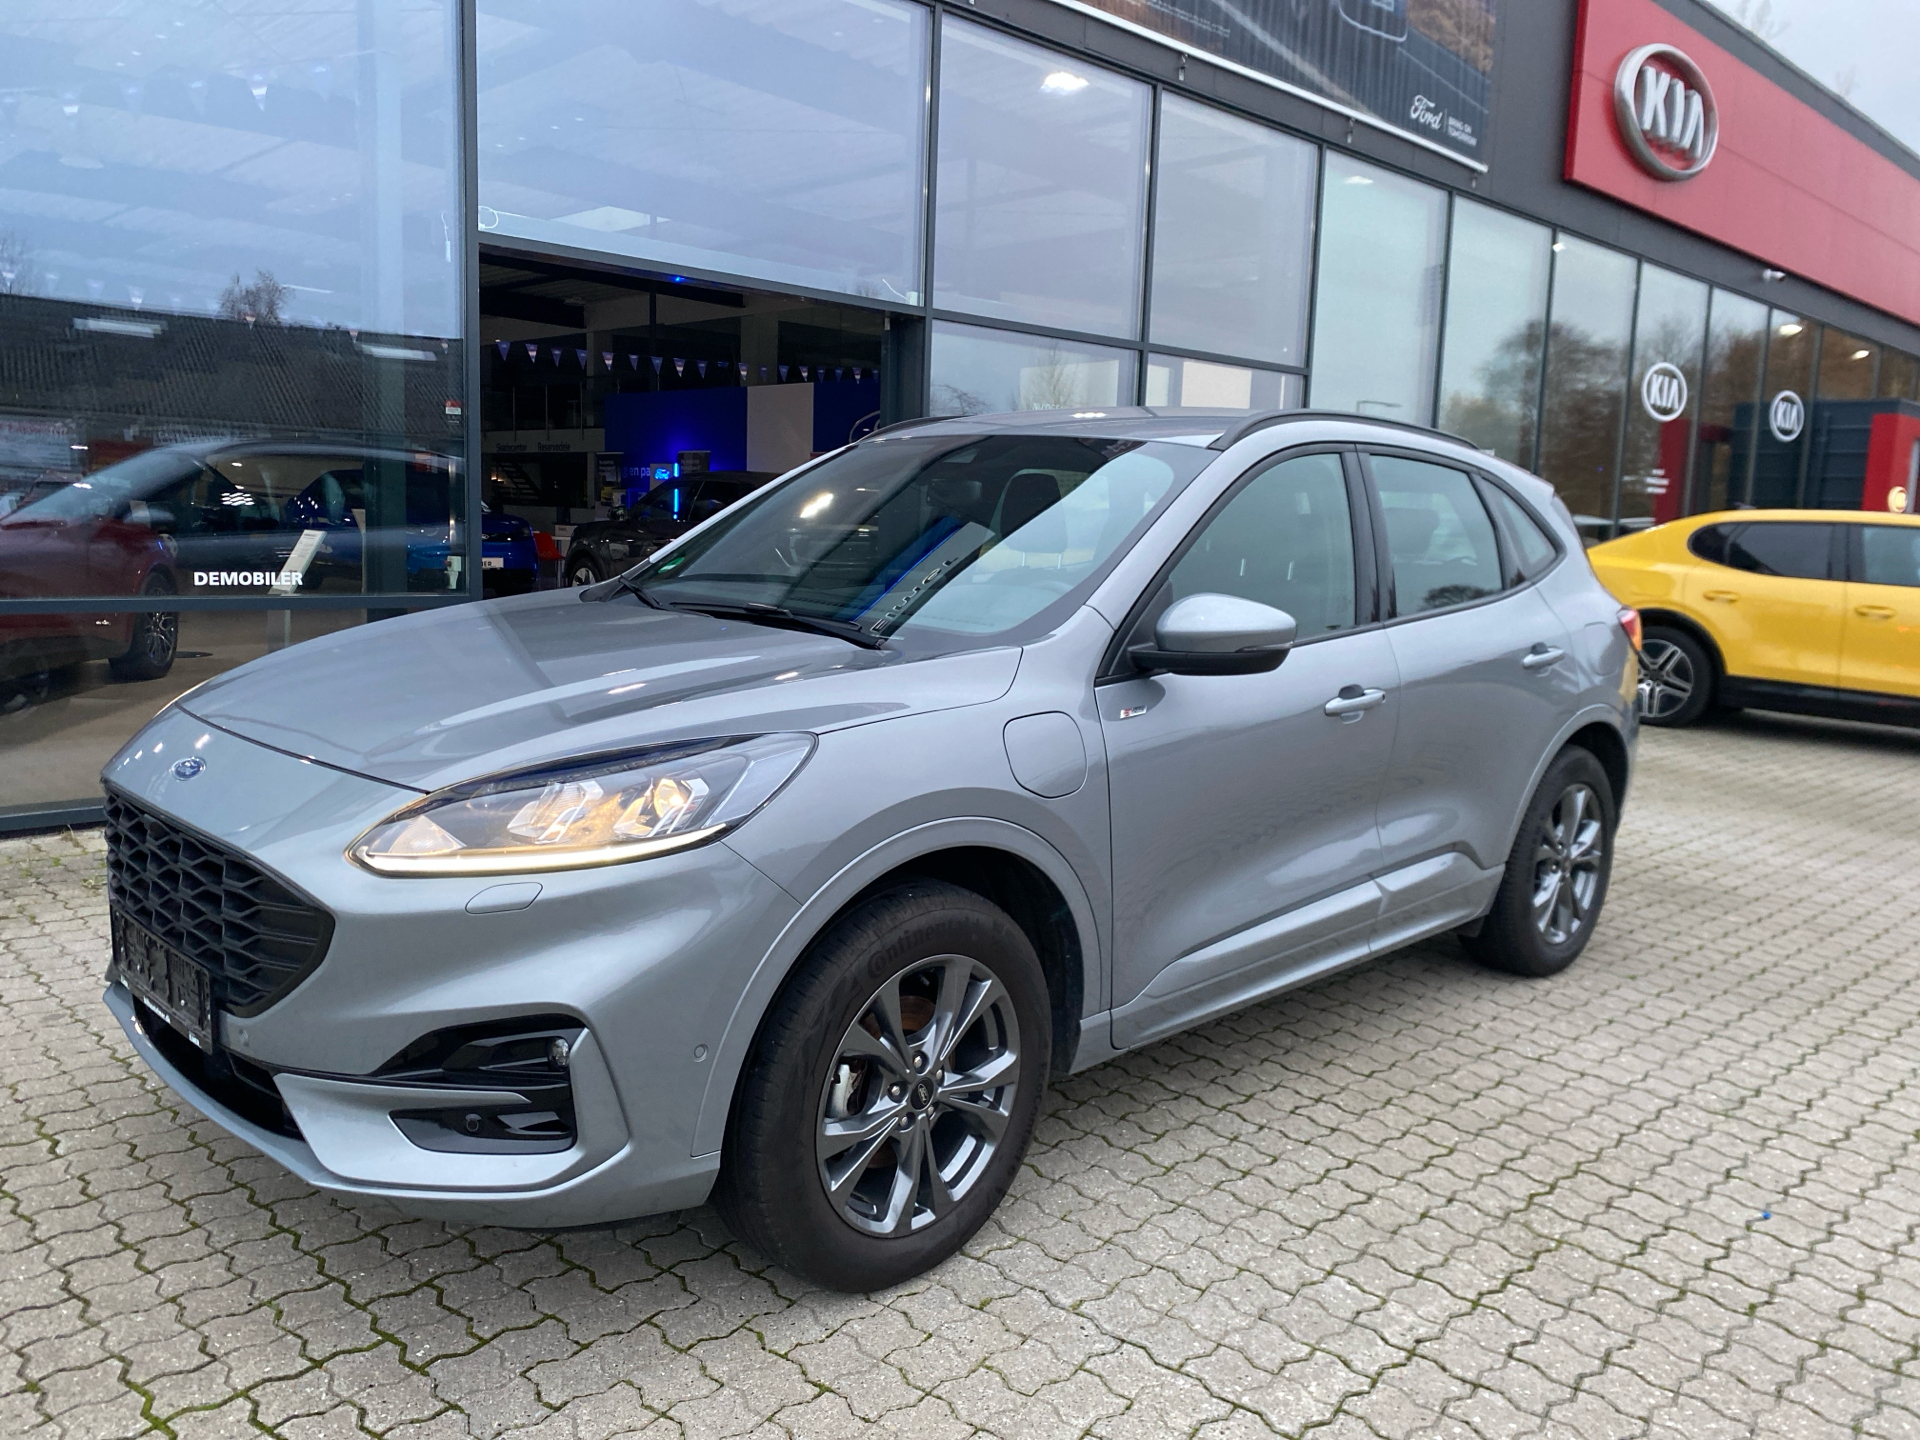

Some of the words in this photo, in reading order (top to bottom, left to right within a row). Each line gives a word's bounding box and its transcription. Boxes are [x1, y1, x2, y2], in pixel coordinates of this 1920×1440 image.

[1409, 94, 1443, 131] Ford
[1639, 65, 1705, 160] KIA
[1649, 373, 1679, 410] KIA
[1776, 401, 1800, 432] KIA
[537, 441, 571, 451] Reservedele
[193, 571, 303, 586] DEMOBILER
[867, 916, 979, 979] Continental
